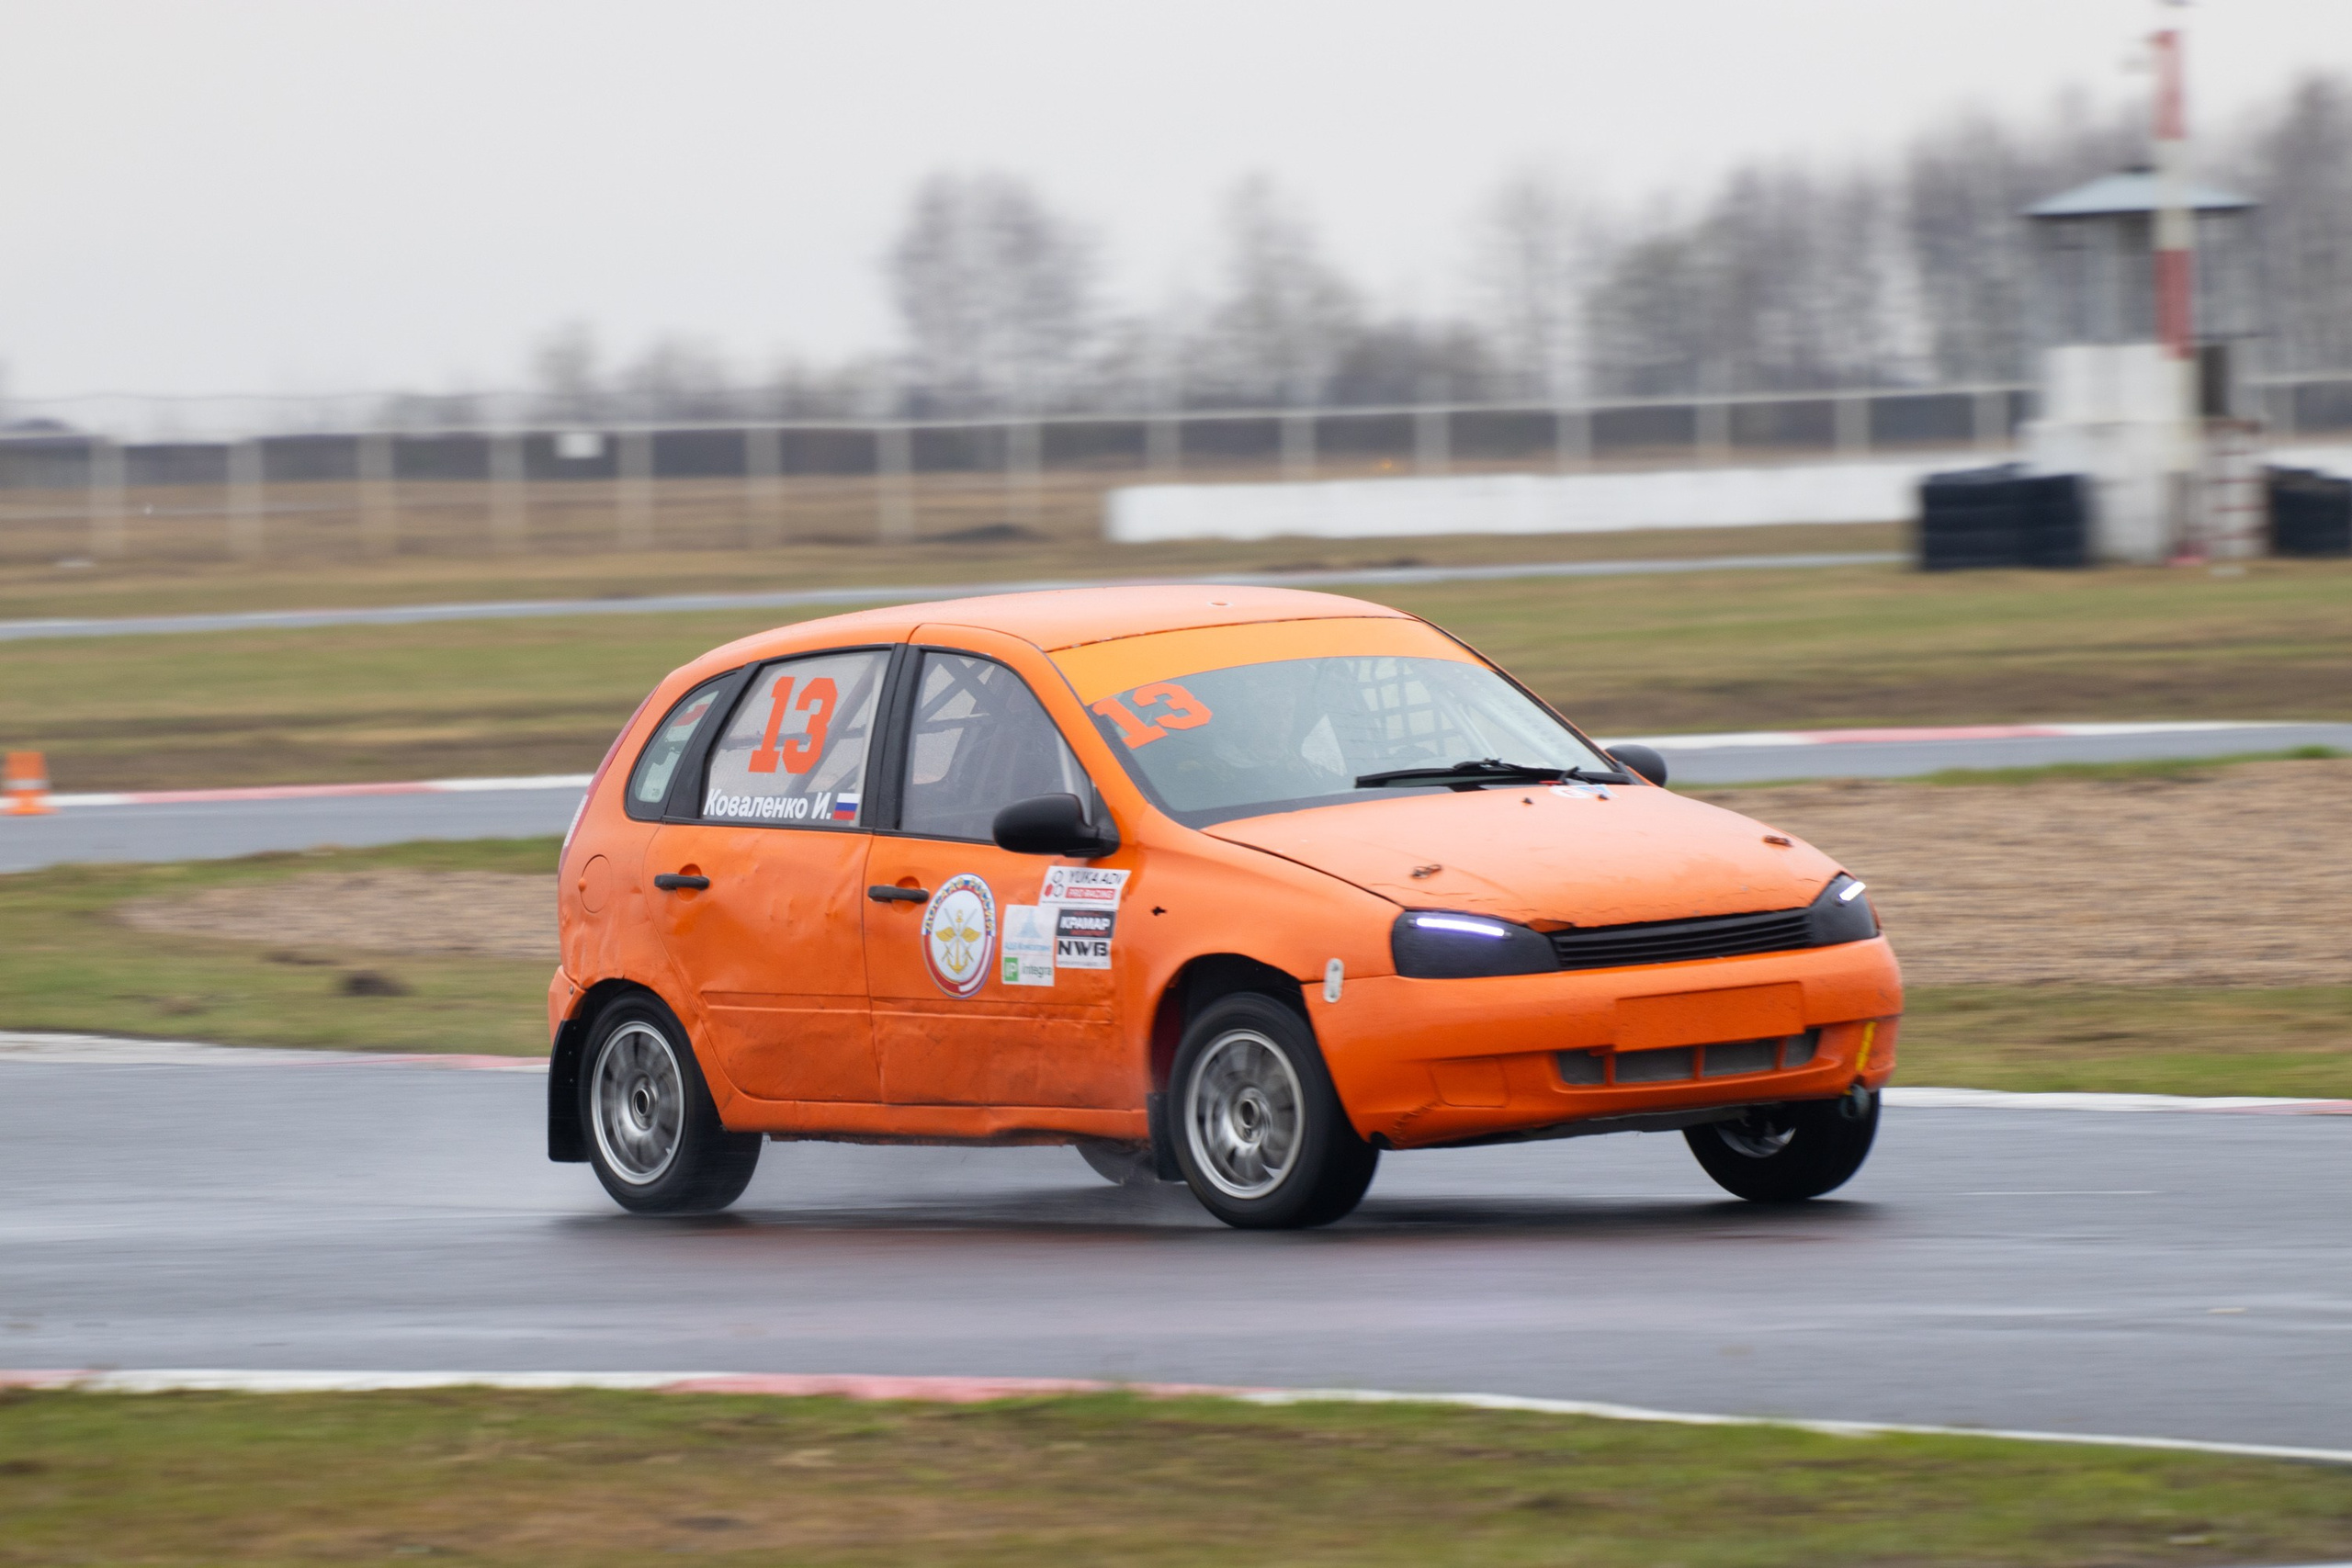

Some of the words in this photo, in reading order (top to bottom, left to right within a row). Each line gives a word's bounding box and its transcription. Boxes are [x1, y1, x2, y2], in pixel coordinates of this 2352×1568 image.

[1091, 682, 1213, 750] 13
[748, 676, 838, 774] 13
[703, 788, 808, 818] Коваленко
[811, 792, 831, 819] И.
[1069, 870, 1099, 885] YUKA
[1058, 916, 1111, 931] КРАМАР
[1058, 941, 1108, 957] NWB
[1022, 963, 1052, 978] integra
